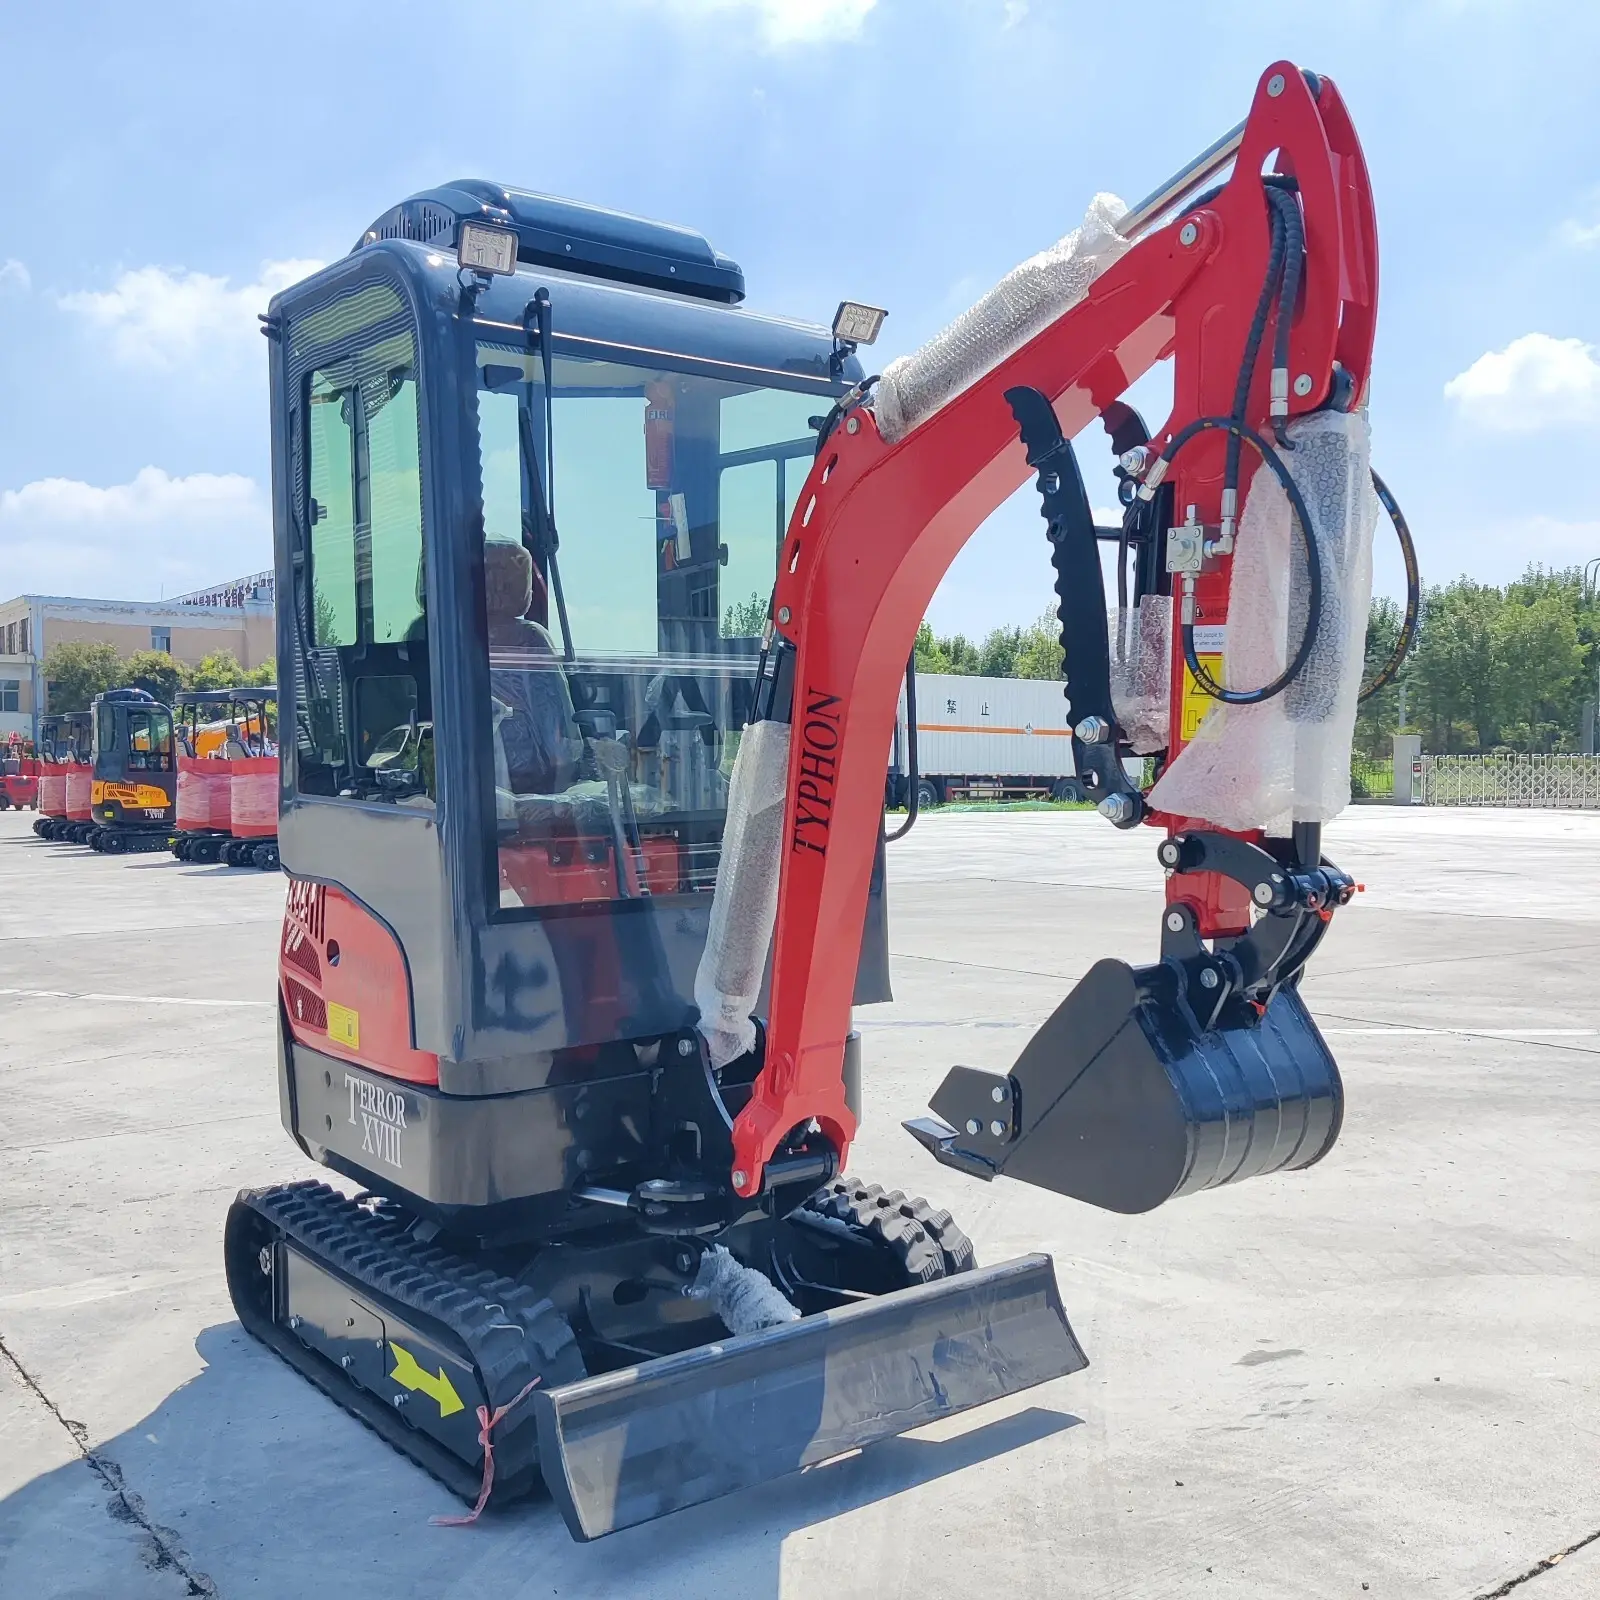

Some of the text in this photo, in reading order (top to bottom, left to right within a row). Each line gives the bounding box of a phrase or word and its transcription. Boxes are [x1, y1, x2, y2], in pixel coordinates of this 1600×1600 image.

[791, 686, 845, 857] TYPHON
[344, 1072, 407, 1129] TERROR
[361, 1111, 404, 1169] XVIII
